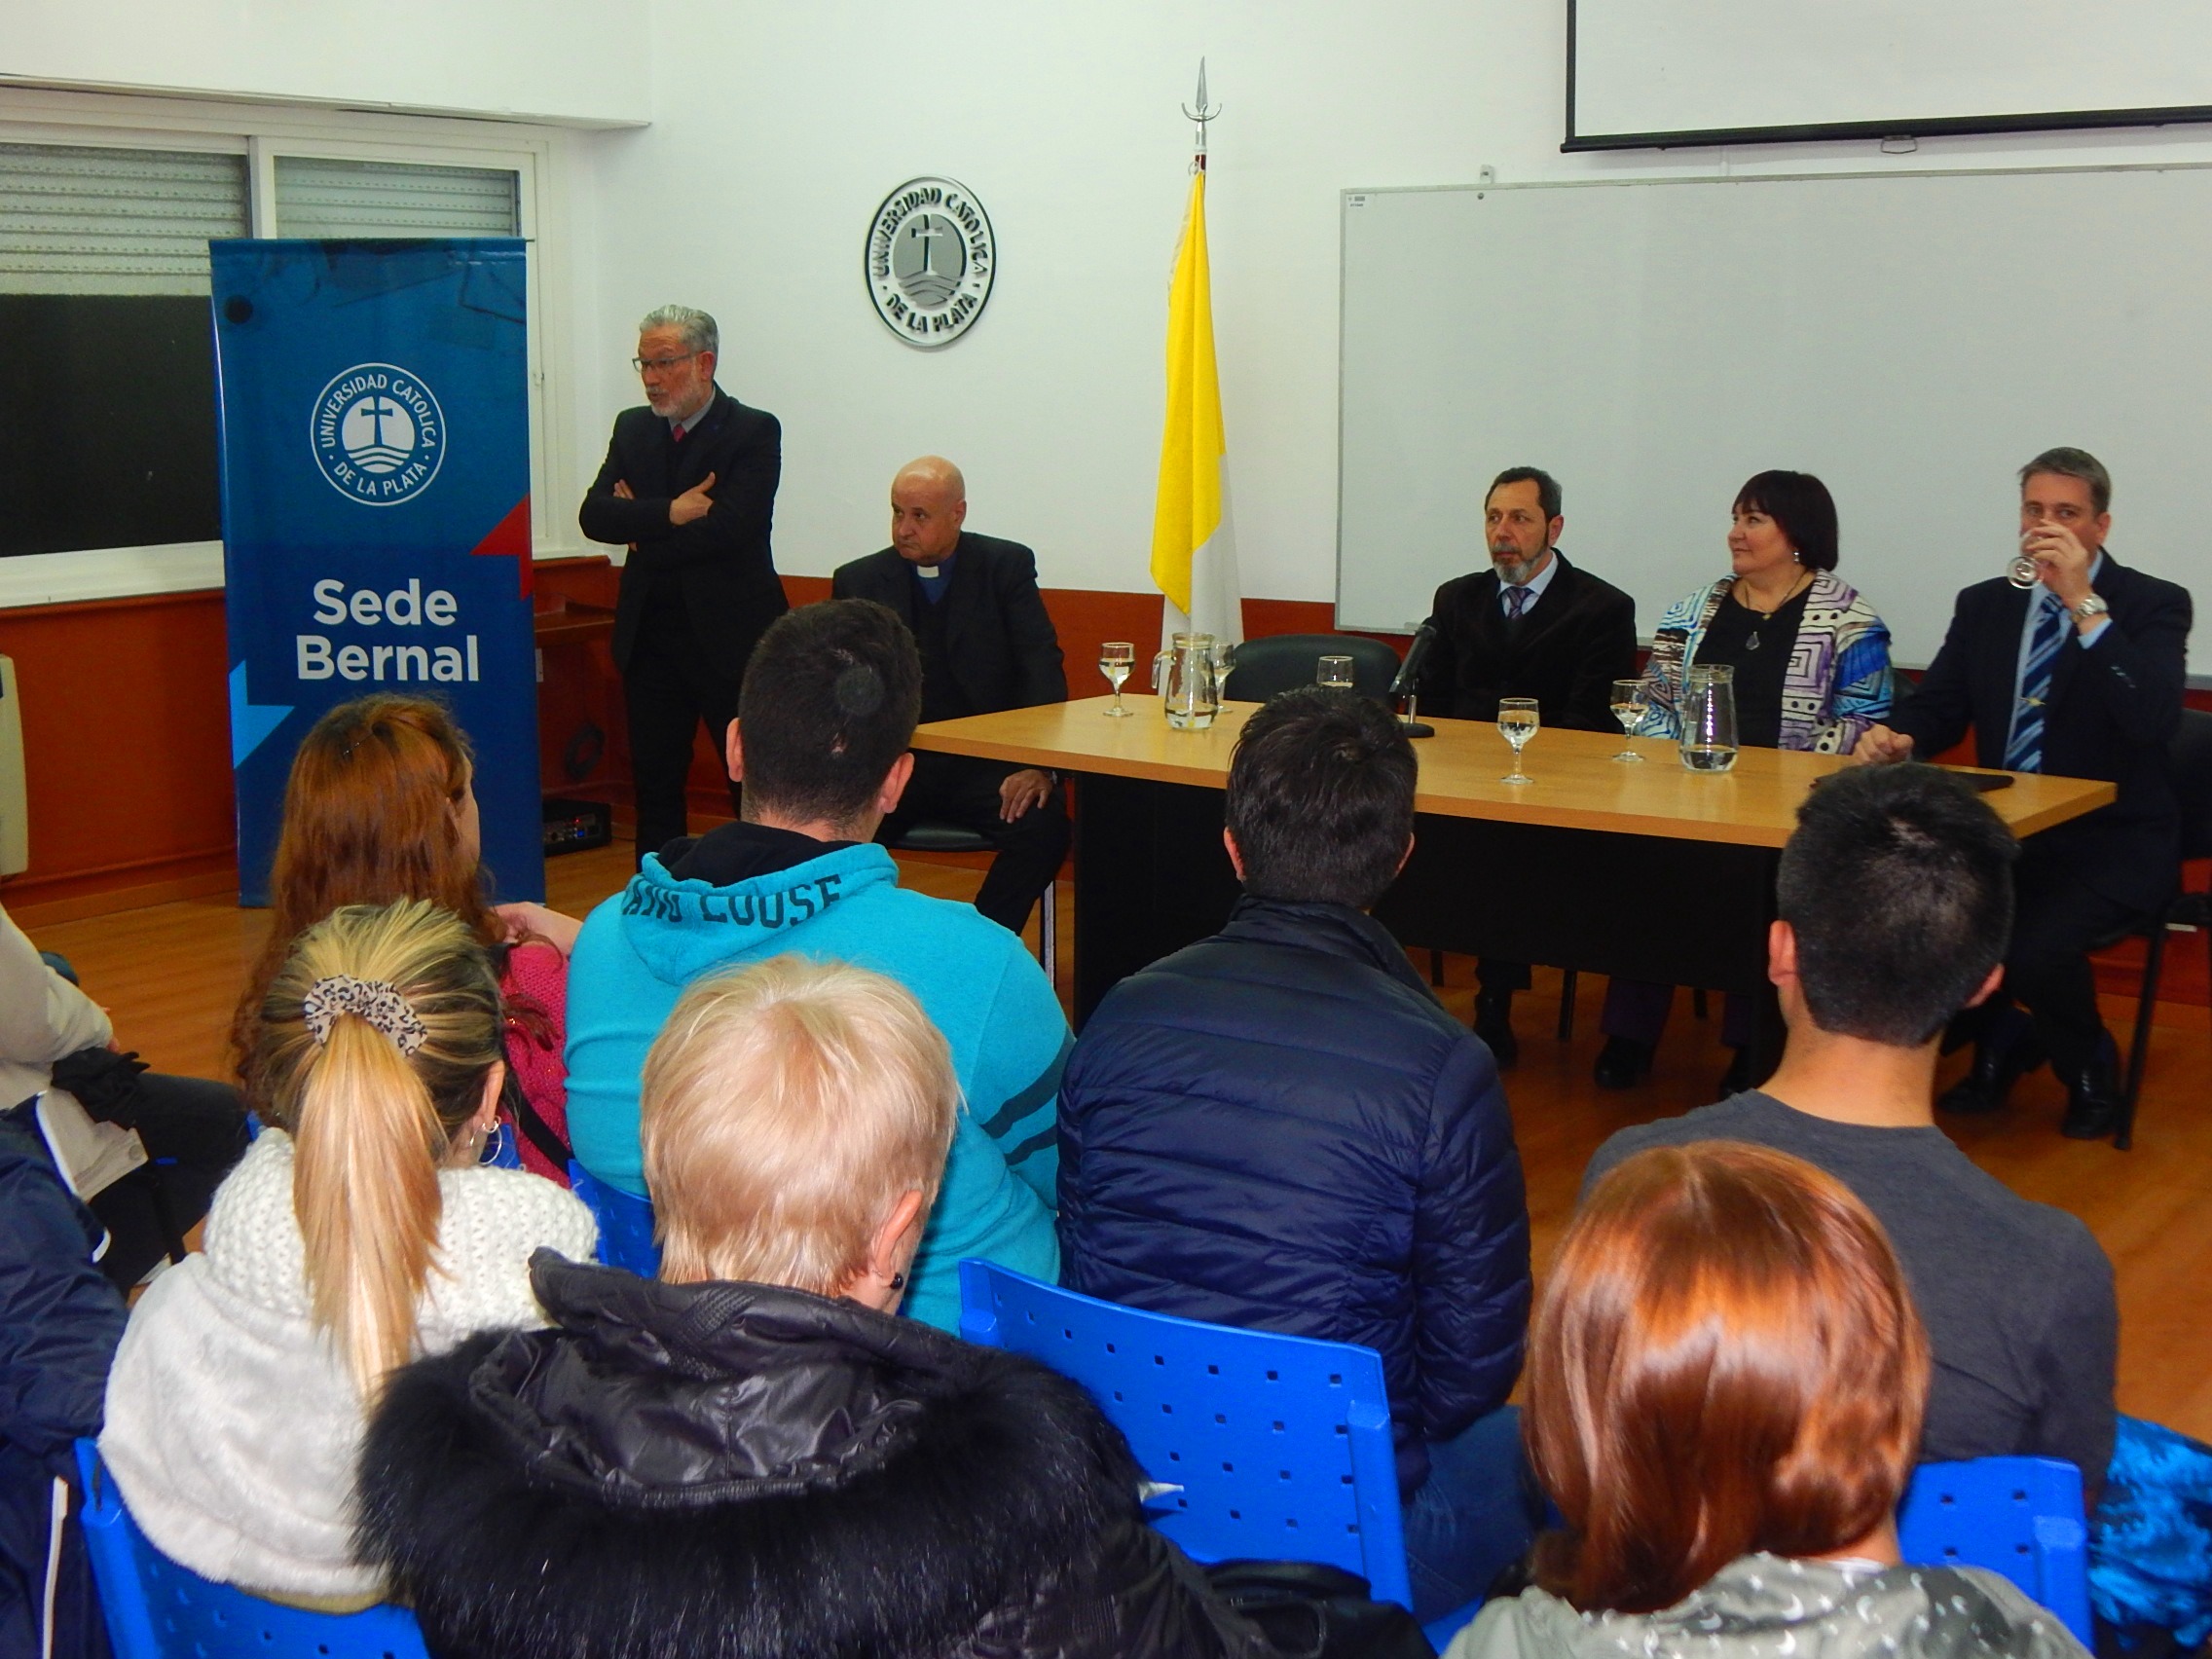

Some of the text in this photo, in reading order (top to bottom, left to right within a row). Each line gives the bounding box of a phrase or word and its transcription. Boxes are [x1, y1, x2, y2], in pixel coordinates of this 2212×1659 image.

[873, 187, 988, 277] UNIVERSIDAD CATOLICA
[886, 292, 977, 333] DE LA PLATA
[319, 373, 437, 449] UNIVERSIDAD CATOLICA
[333, 461, 428, 497] DE LA PLATA
[312, 577, 459, 627] Sede
[295, 634, 480, 682] Bernal
